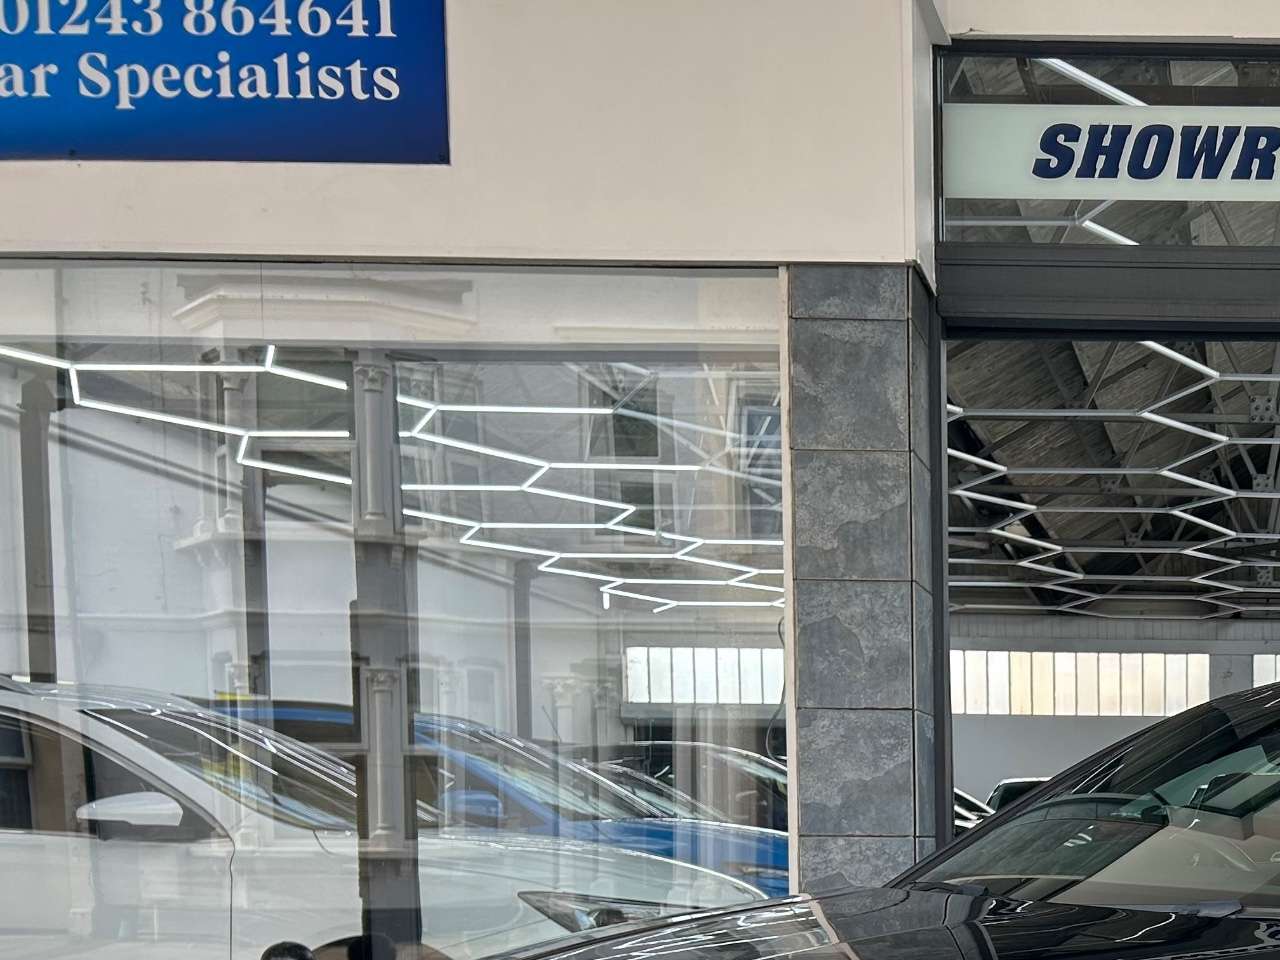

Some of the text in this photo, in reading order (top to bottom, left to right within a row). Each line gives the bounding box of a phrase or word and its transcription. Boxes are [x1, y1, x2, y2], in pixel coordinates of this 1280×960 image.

[0, 0, 397, 37] 01243 864641
[77, 50, 400, 110] Specialists
